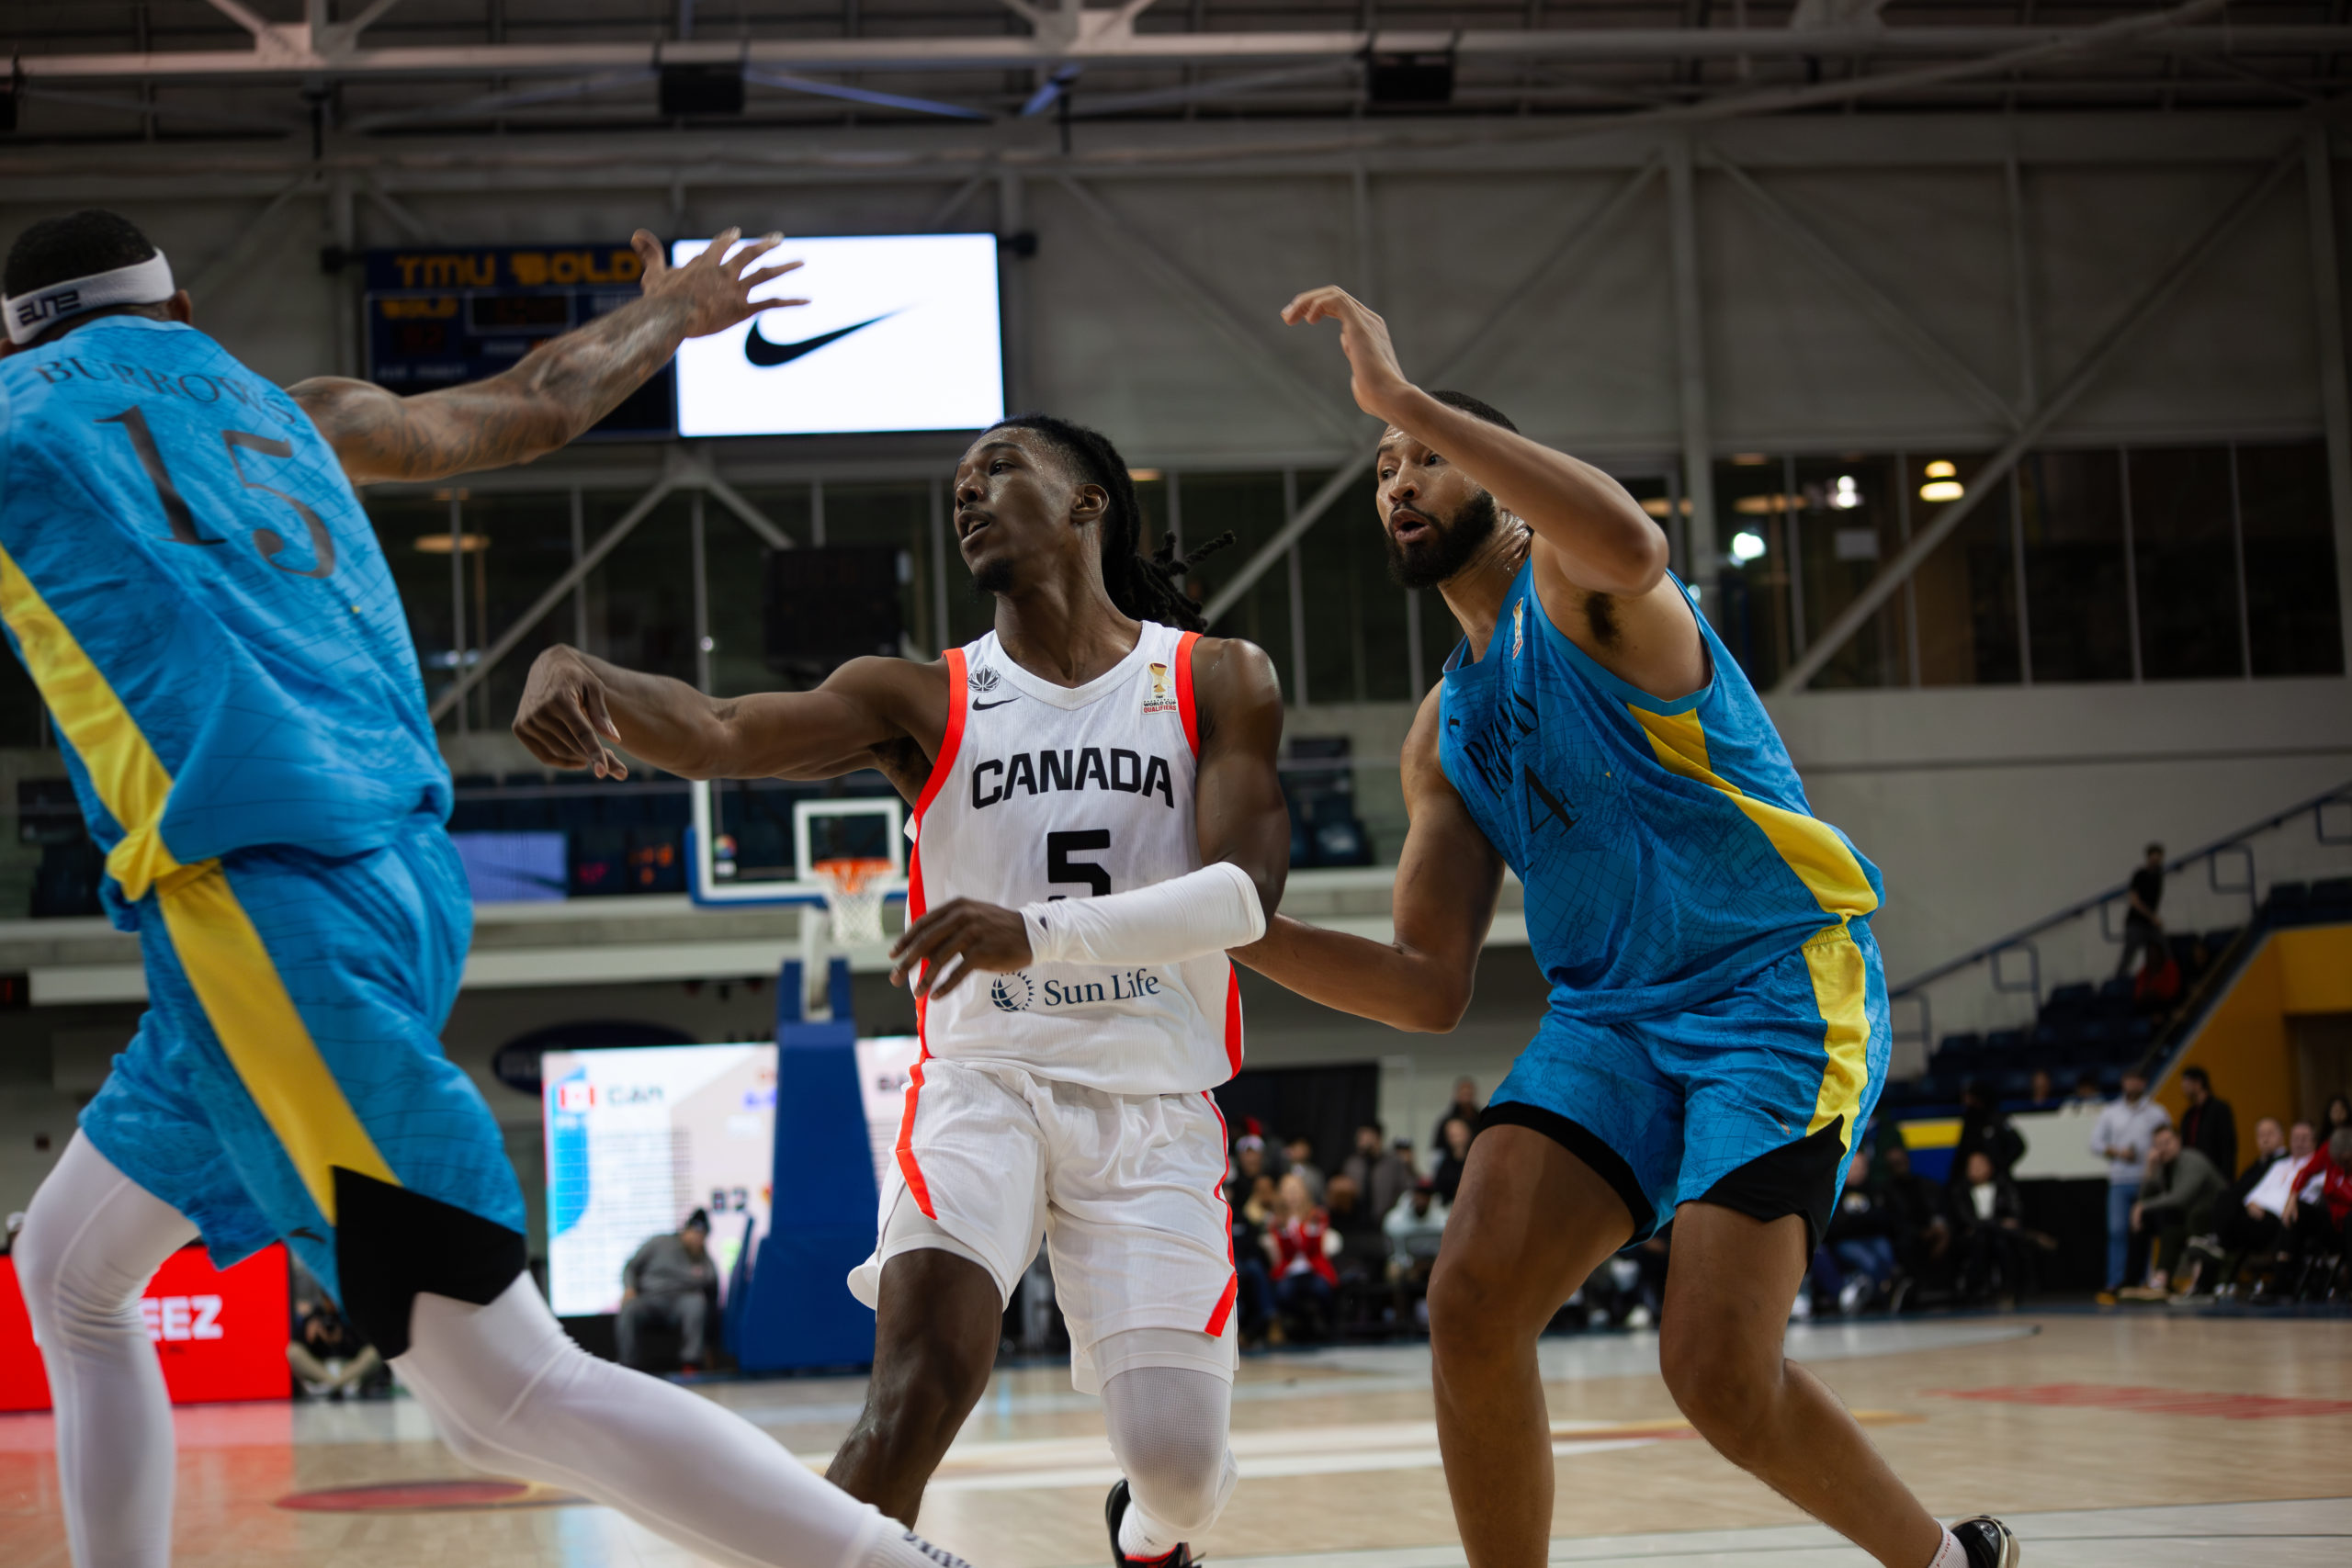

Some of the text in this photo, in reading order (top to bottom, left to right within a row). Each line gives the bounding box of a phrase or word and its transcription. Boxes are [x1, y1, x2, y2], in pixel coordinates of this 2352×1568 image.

[394, 254, 496, 288] TMU
[35, 356, 296, 425] BURROWS
[93, 404, 335, 579] 15
[1143, 705, 1177, 714] QUALIFIERS
[972, 748, 1174, 809] CANADA
[1047, 829, 1111, 902] 5
[1044, 968, 1161, 1007] Sun Life
